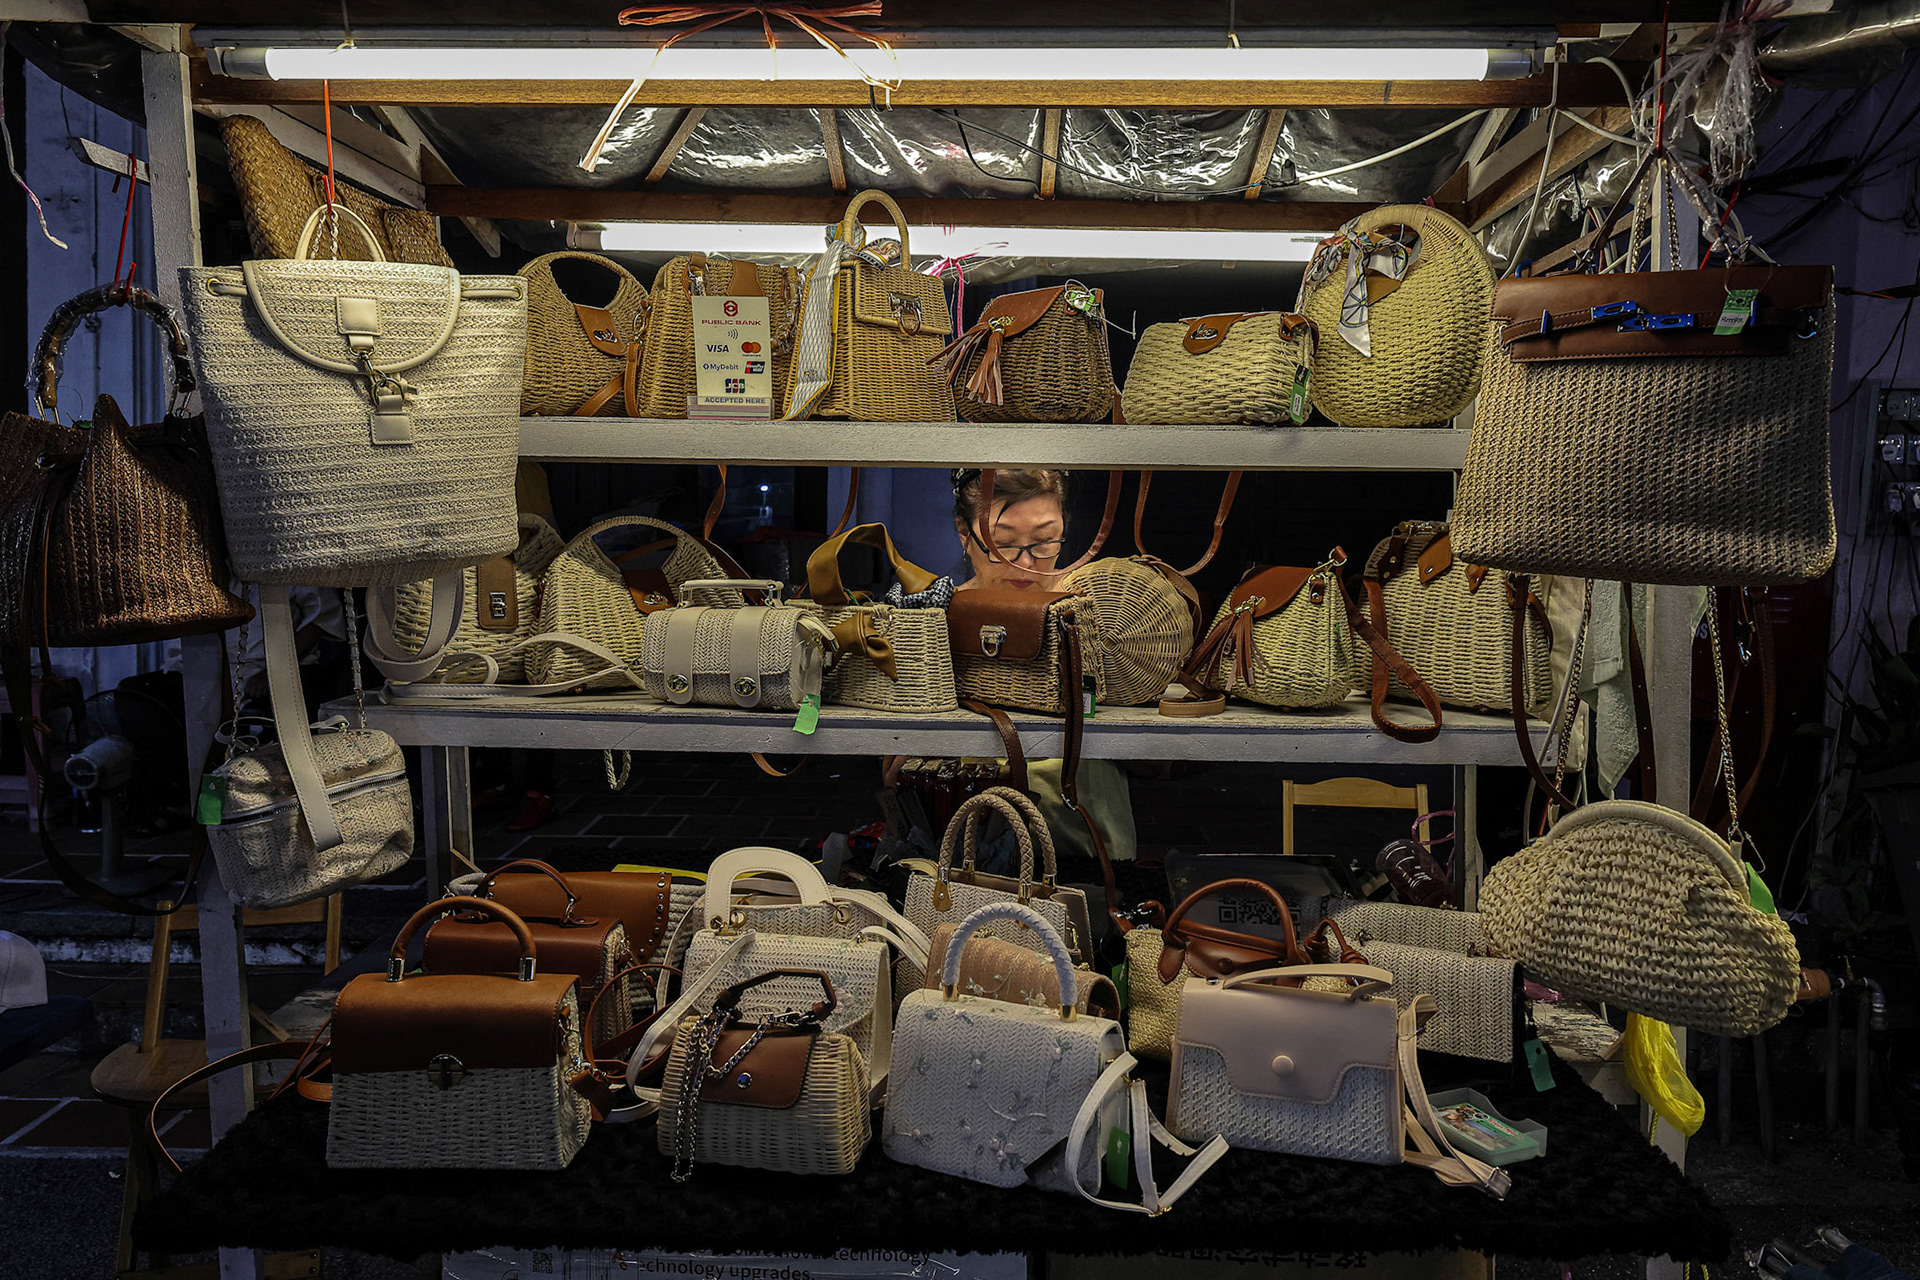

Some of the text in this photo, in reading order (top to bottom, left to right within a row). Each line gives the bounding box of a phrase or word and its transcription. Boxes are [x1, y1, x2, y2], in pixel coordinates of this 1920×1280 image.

[706, 344, 729, 353] VISA
[710, 363, 739, 371] MyDebit
[726, 380, 745, 391] JCB
